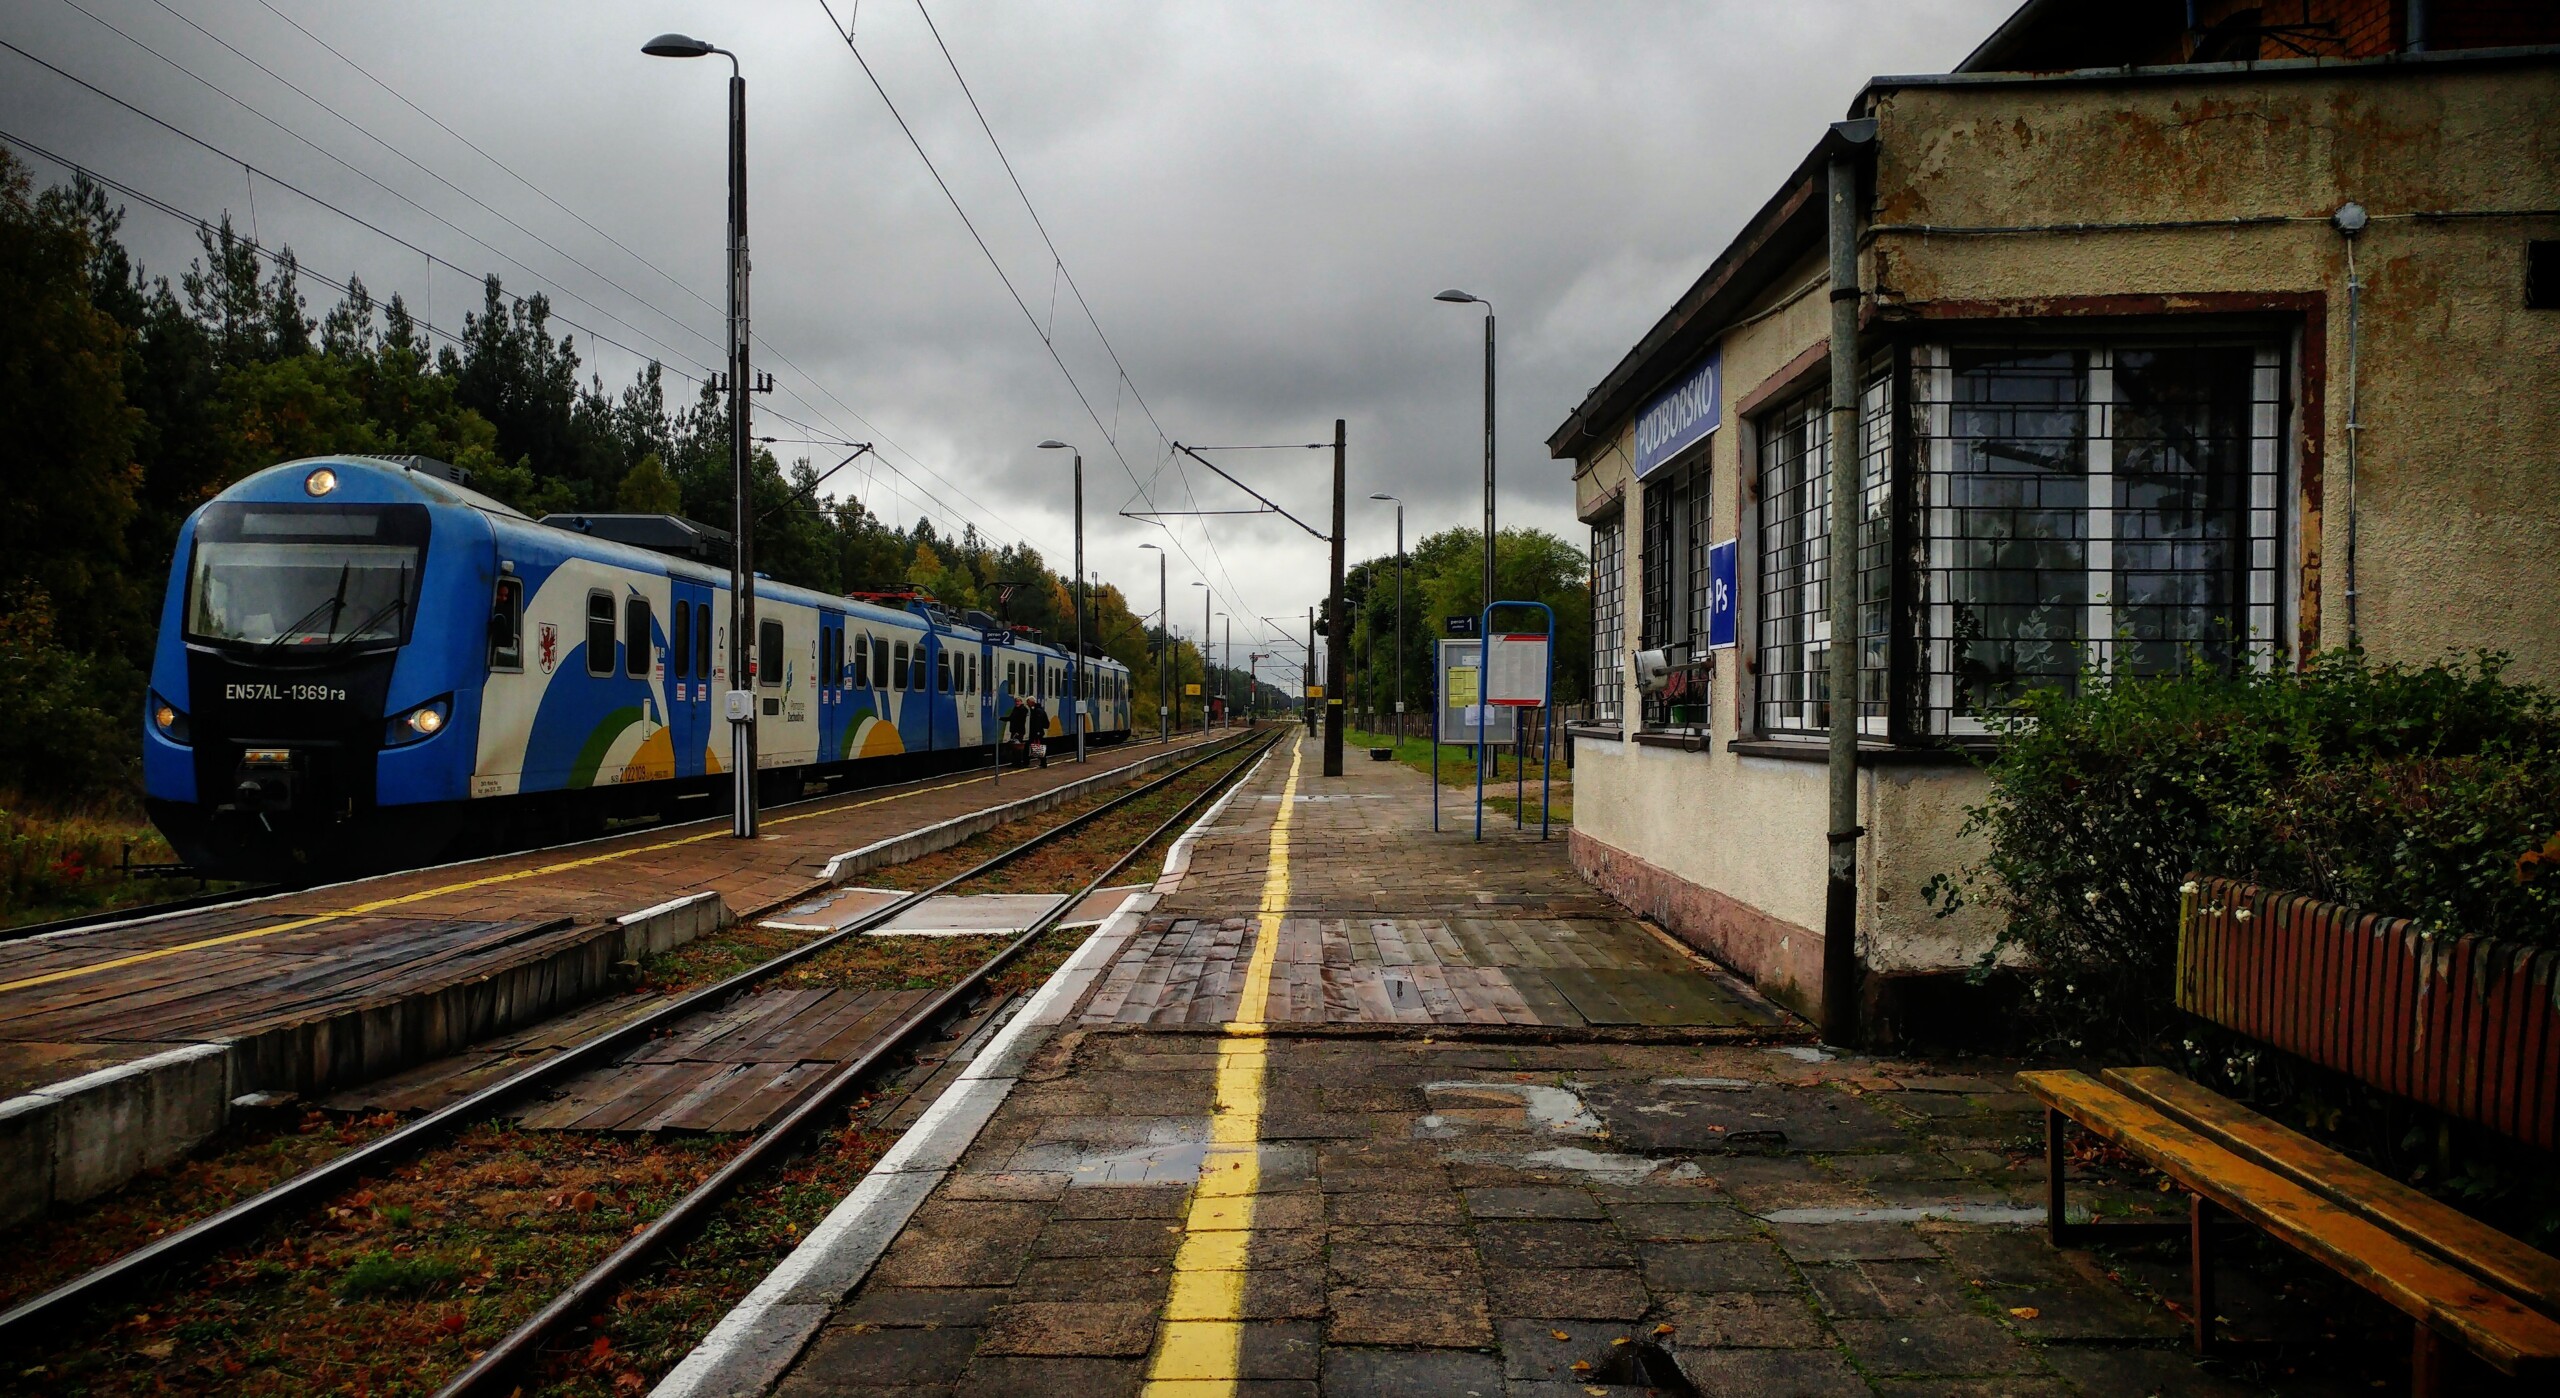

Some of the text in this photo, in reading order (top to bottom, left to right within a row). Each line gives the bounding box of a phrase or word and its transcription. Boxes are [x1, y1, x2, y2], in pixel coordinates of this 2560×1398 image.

[1639, 365, 1713, 460] PODBORSKO
[1715, 577, 1728, 615] Ps
[1466, 616, 1473, 631] 1
[718, 626, 725, 650] 2
[1002, 630, 1010, 645] 2
[811, 639, 817, 660] 2
[225, 683, 346, 701] EN57AL-1369 ra
